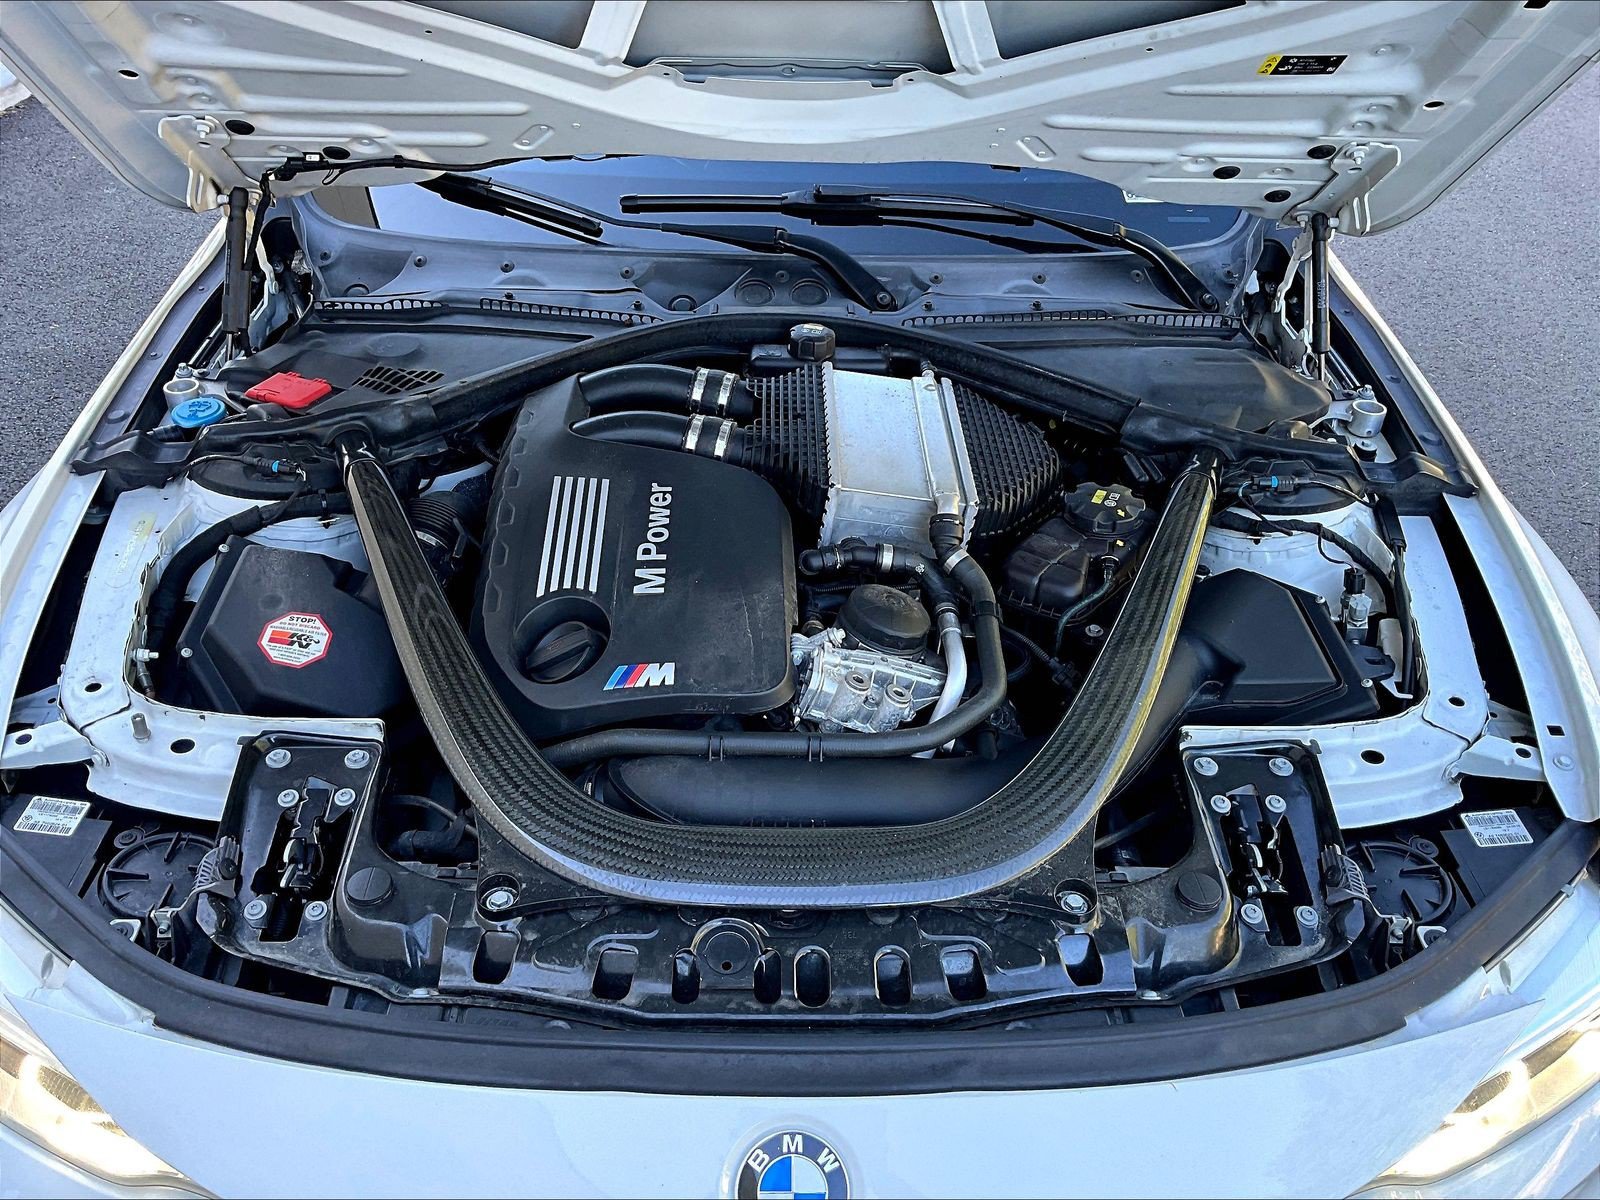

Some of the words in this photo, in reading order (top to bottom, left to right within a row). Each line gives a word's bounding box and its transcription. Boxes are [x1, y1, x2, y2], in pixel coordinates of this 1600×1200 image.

[636, 482, 672, 561] Power
[633, 567, 666, 594] M
[289, 616, 317, 624] STOP!
[747, 1134, 840, 1173] BMW
